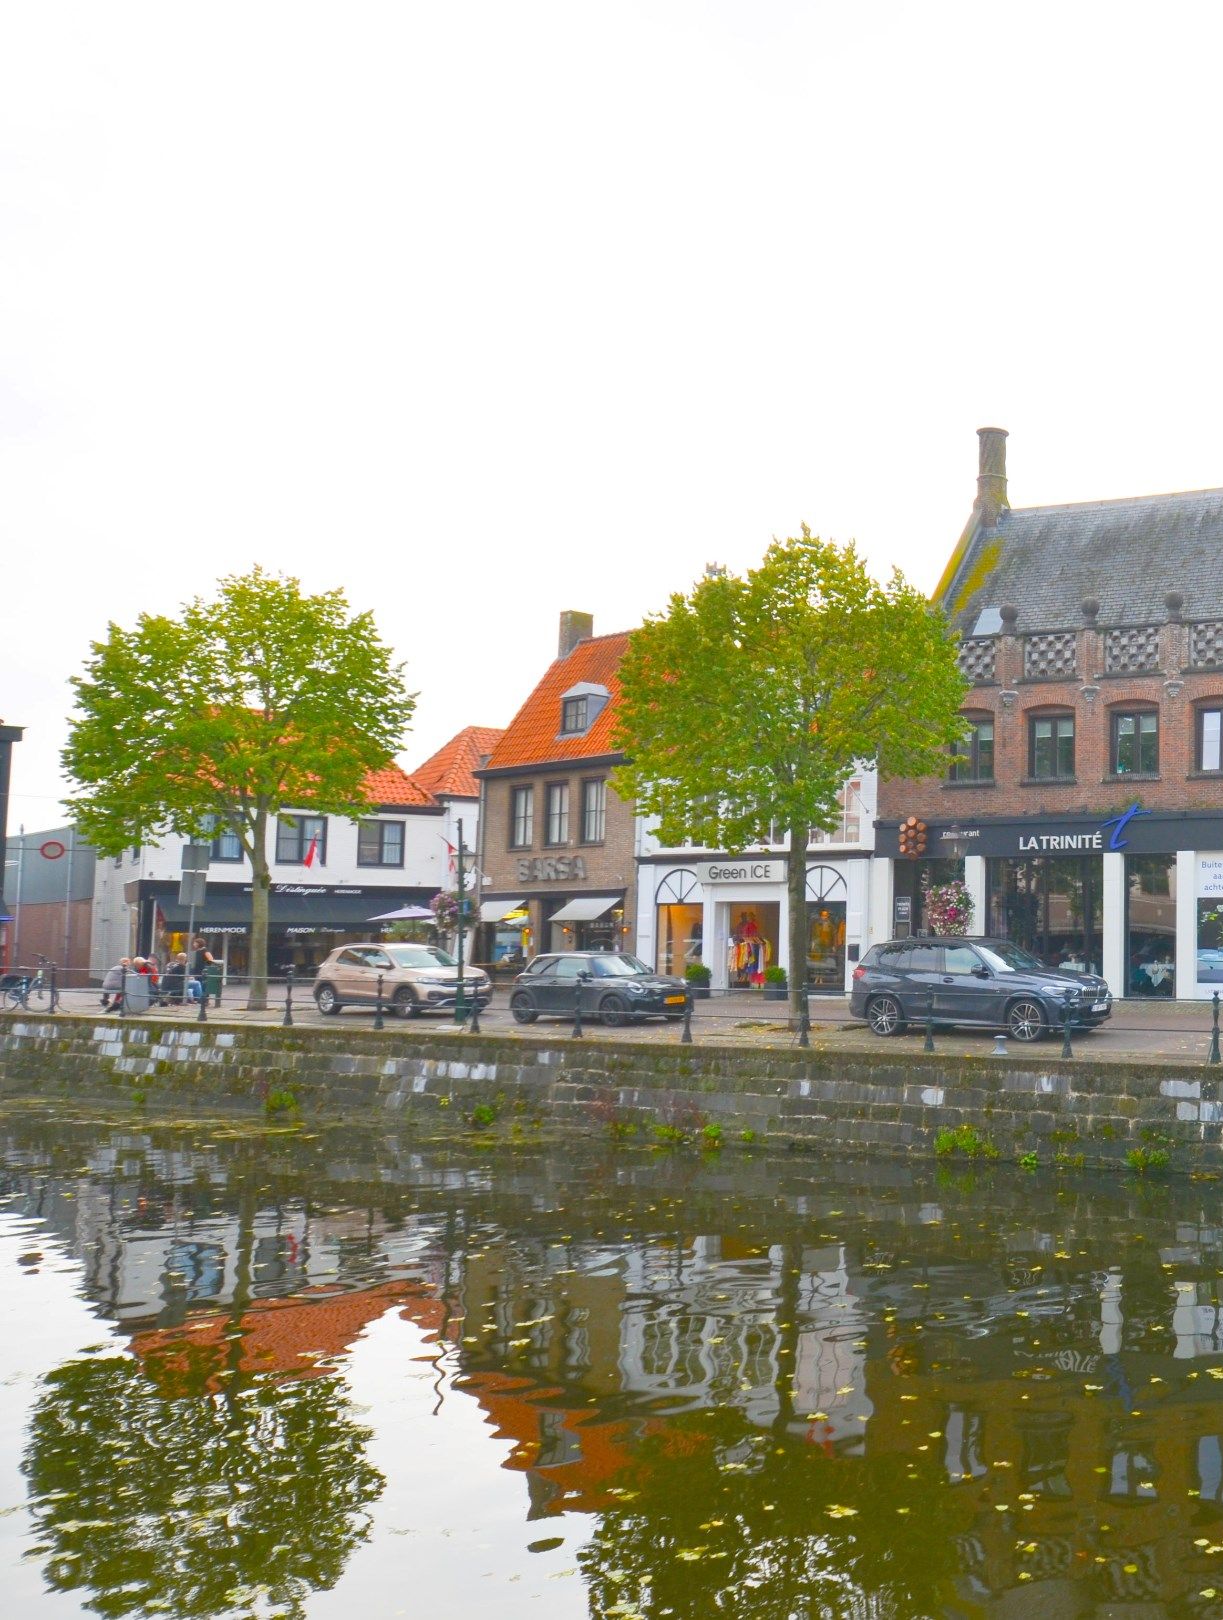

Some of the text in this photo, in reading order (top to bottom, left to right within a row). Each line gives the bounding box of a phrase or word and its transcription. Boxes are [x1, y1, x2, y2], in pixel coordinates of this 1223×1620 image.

[1018, 836, 1039, 850] LA
[1039, 831, 1103, 850] TRINITÉ
[518, 856, 586, 881] BARSA
[708, 864, 771, 880] Green ICE
[199, 926, 247, 934] HERENMODE
